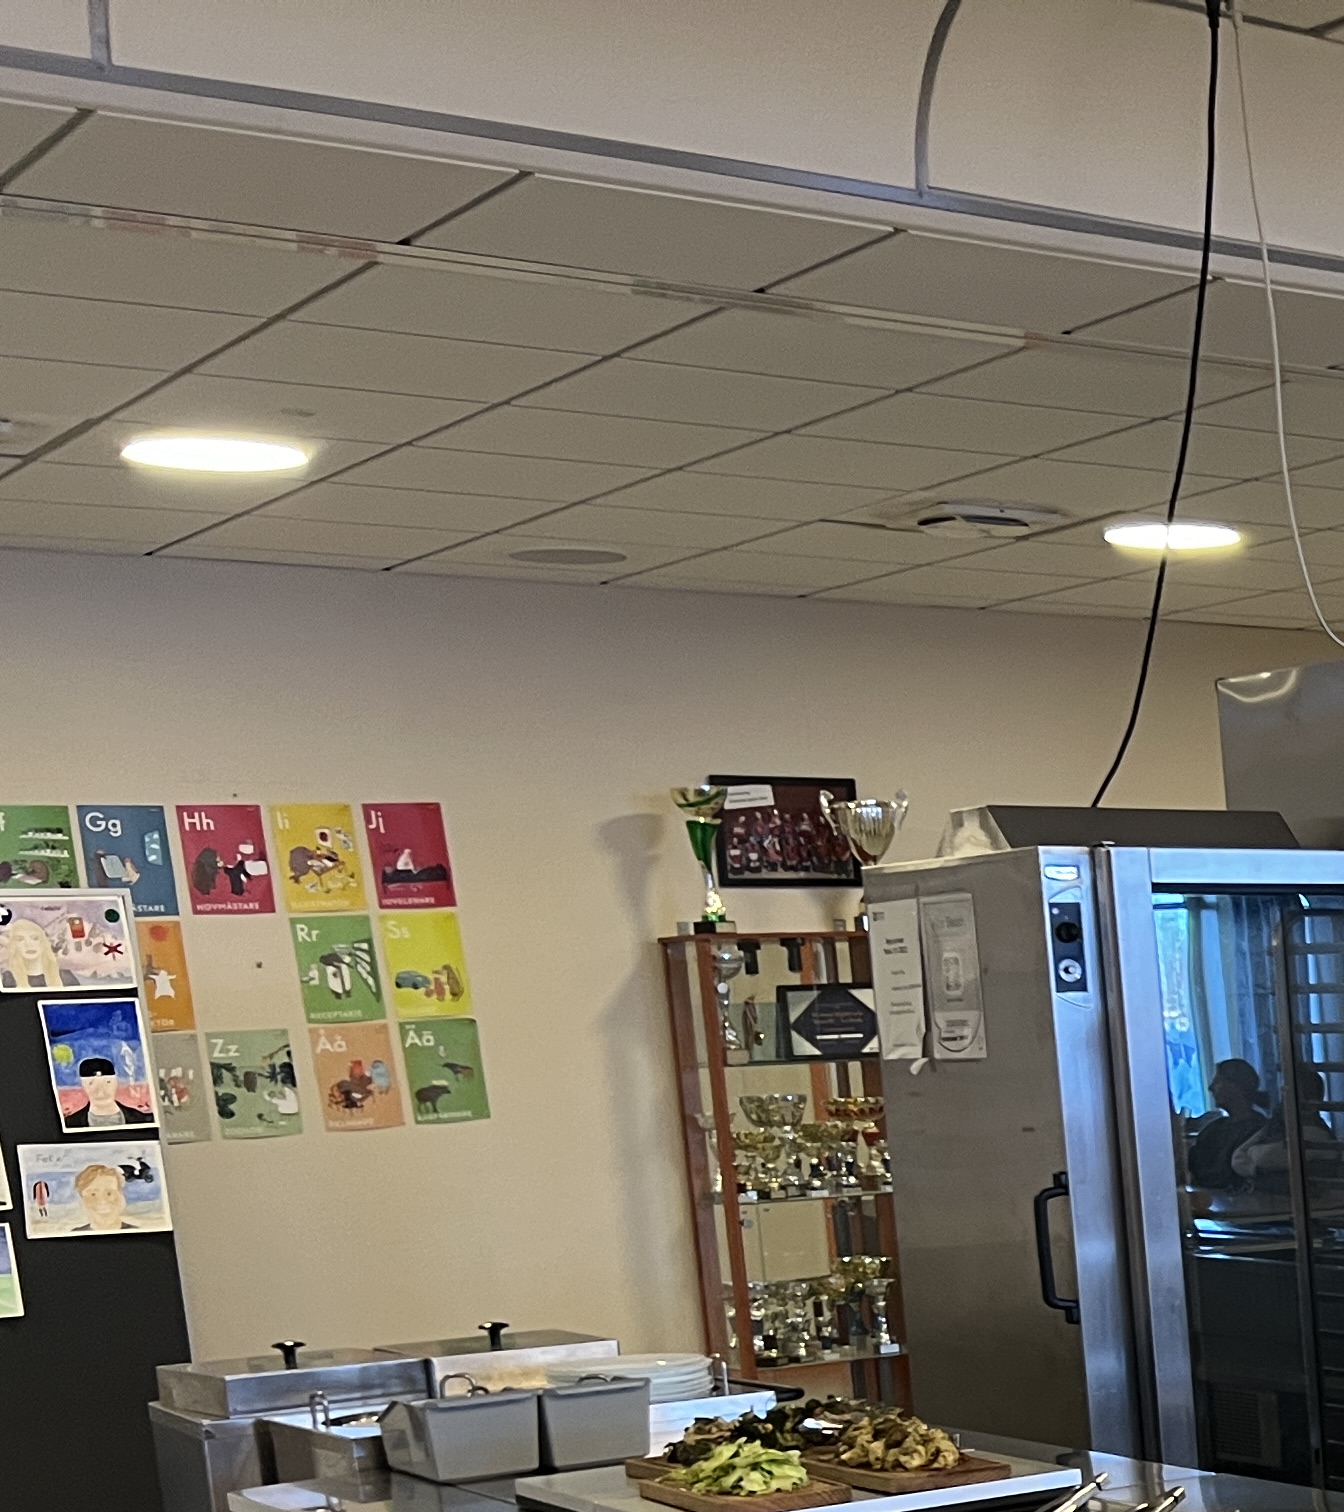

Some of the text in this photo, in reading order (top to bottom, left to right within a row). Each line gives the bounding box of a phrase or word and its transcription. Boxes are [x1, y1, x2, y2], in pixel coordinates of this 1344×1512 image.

[85, 812, 122, 837] Gg
[183, 811, 215, 831] Hh
[368, 810, 386, 833] Jj
[296, 923, 321, 943] Rr
[387, 920, 411, 940] Ss
[316, 1028, 348, 1054] Åå
[405, 1024, 435, 1048] Ää
[210, 1038, 240, 1058] Zz
